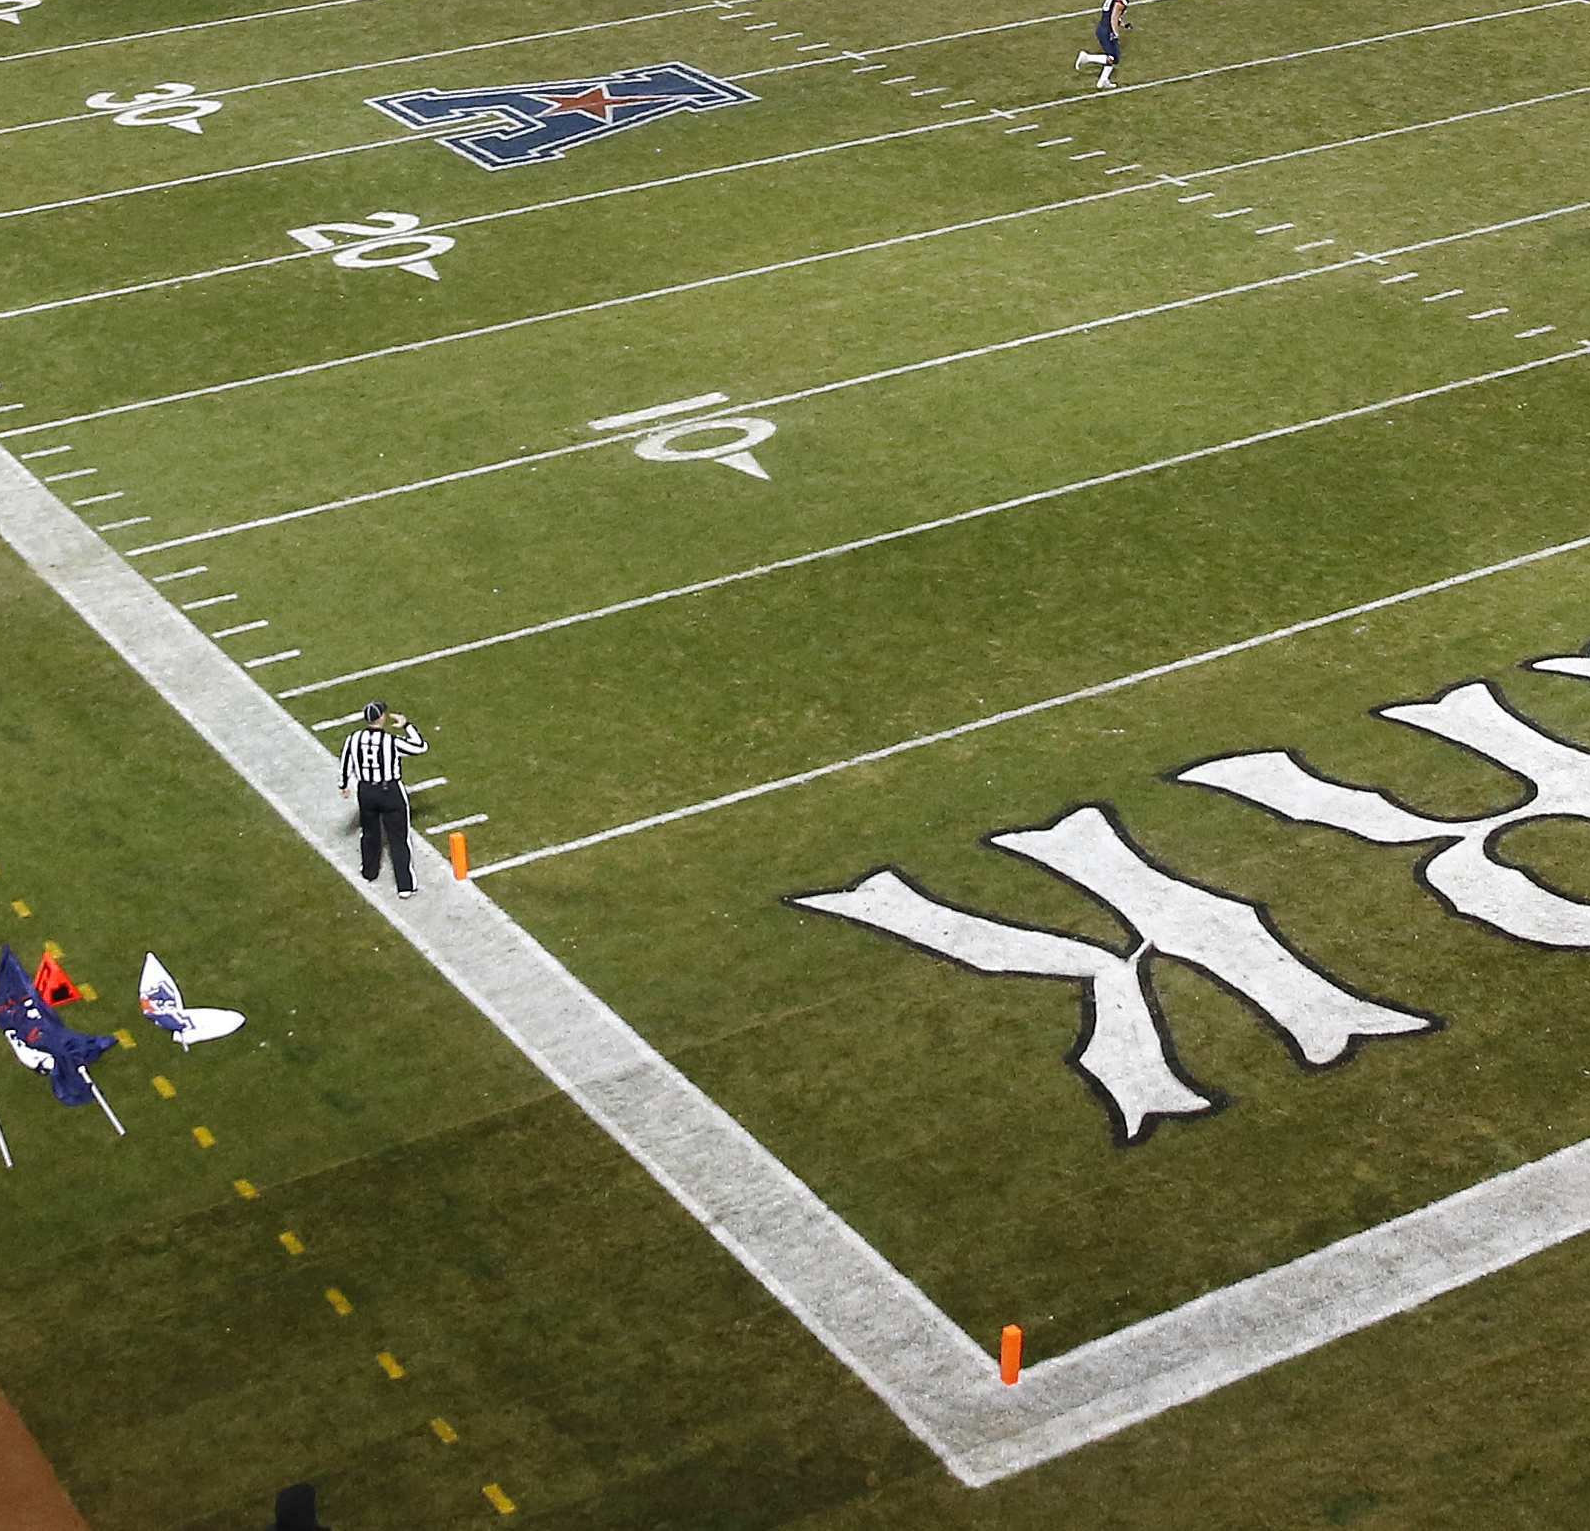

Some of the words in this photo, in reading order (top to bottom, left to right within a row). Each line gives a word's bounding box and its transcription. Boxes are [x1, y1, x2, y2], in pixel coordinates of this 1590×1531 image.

[85, 82, 223, 126] 30
[287, 211, 455, 270] 20
[587, 391, 777, 462] 10
[362, 744, 381, 768] H
